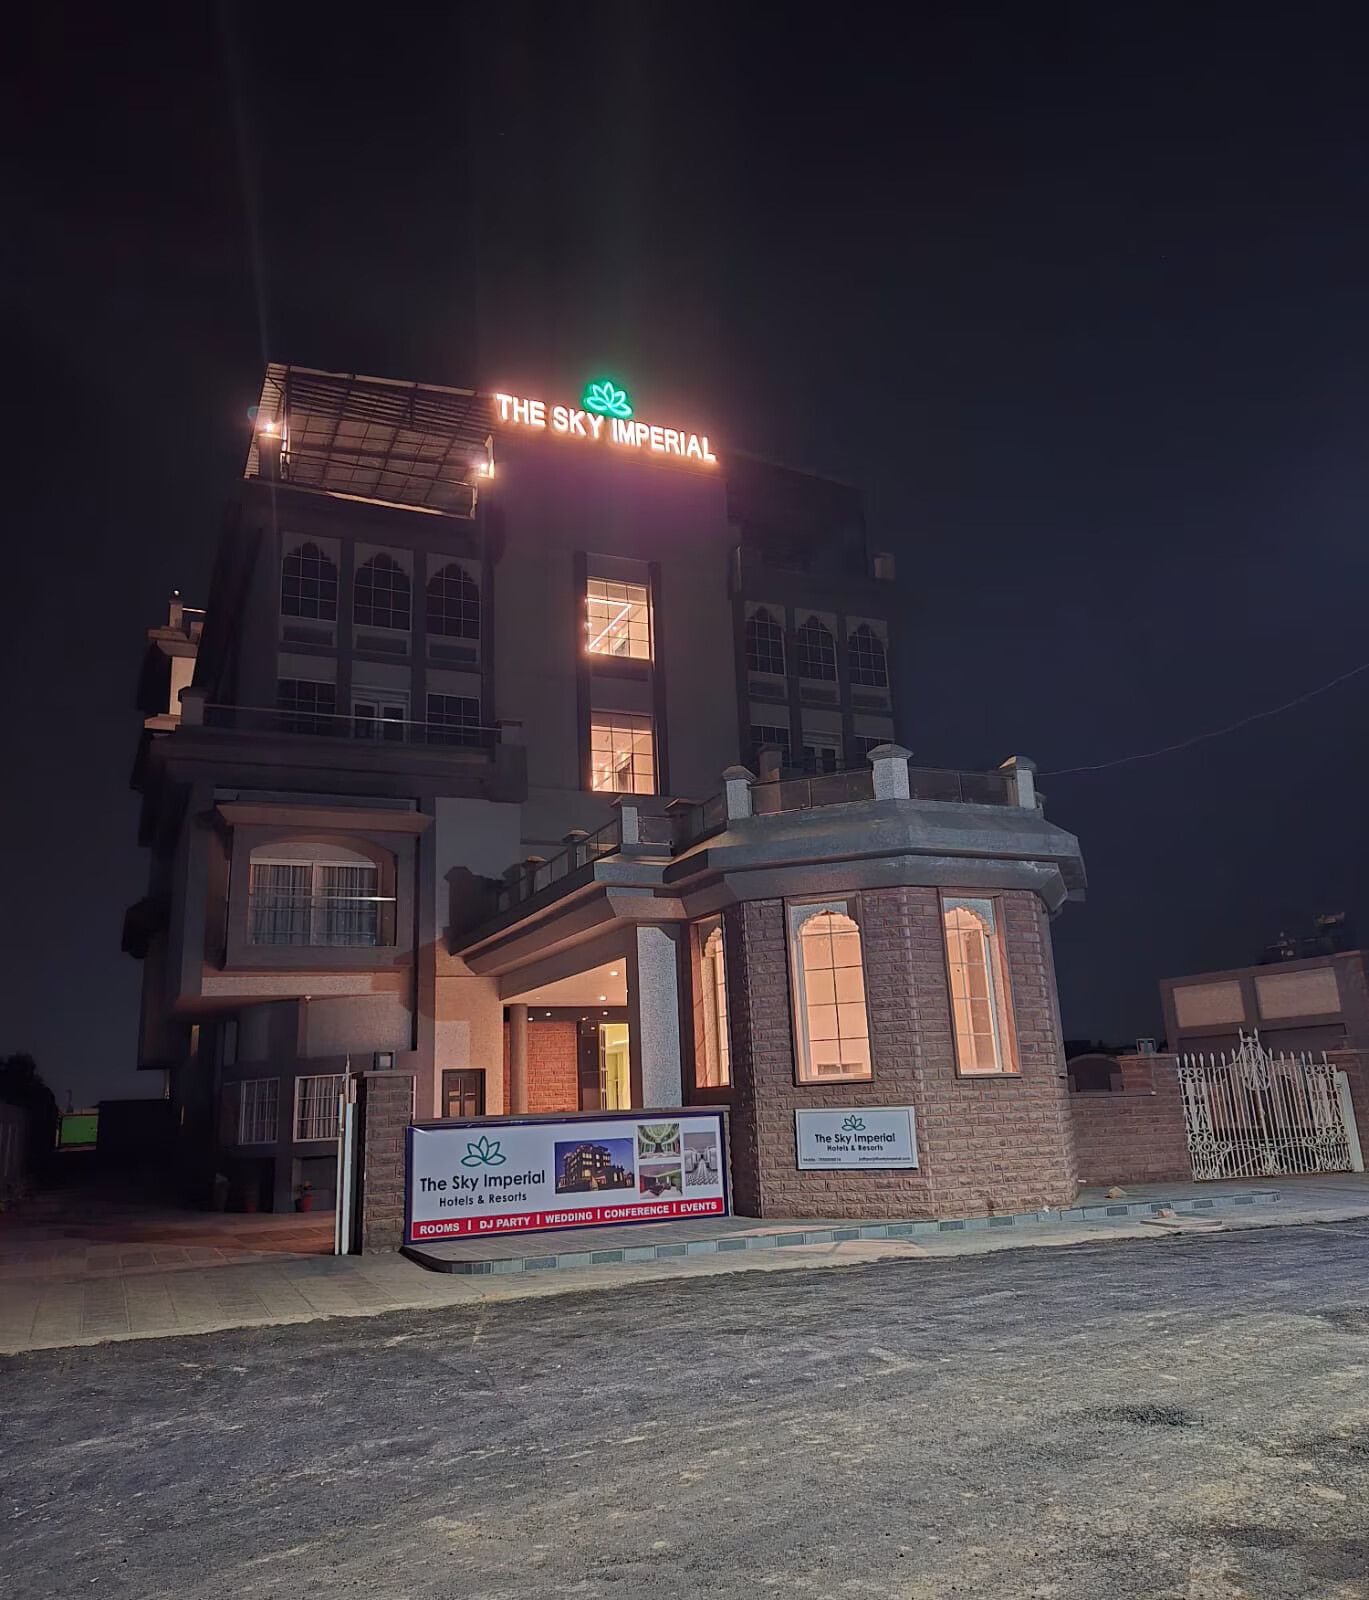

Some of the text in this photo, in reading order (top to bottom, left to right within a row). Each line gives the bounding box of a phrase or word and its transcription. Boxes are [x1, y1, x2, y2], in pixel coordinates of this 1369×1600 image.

[496, 394, 716, 461] THE SKY IMPERIAL
[815, 1133, 896, 1144] The Sky Imperial
[420, 1170, 545, 1192] The Sky Imperial
[439, 1192, 527, 1207] Hotels & Resorts
[420, 1201, 717, 1234] ROOMS DJ PARTY WEDDING CONFERENCE EVENTS
